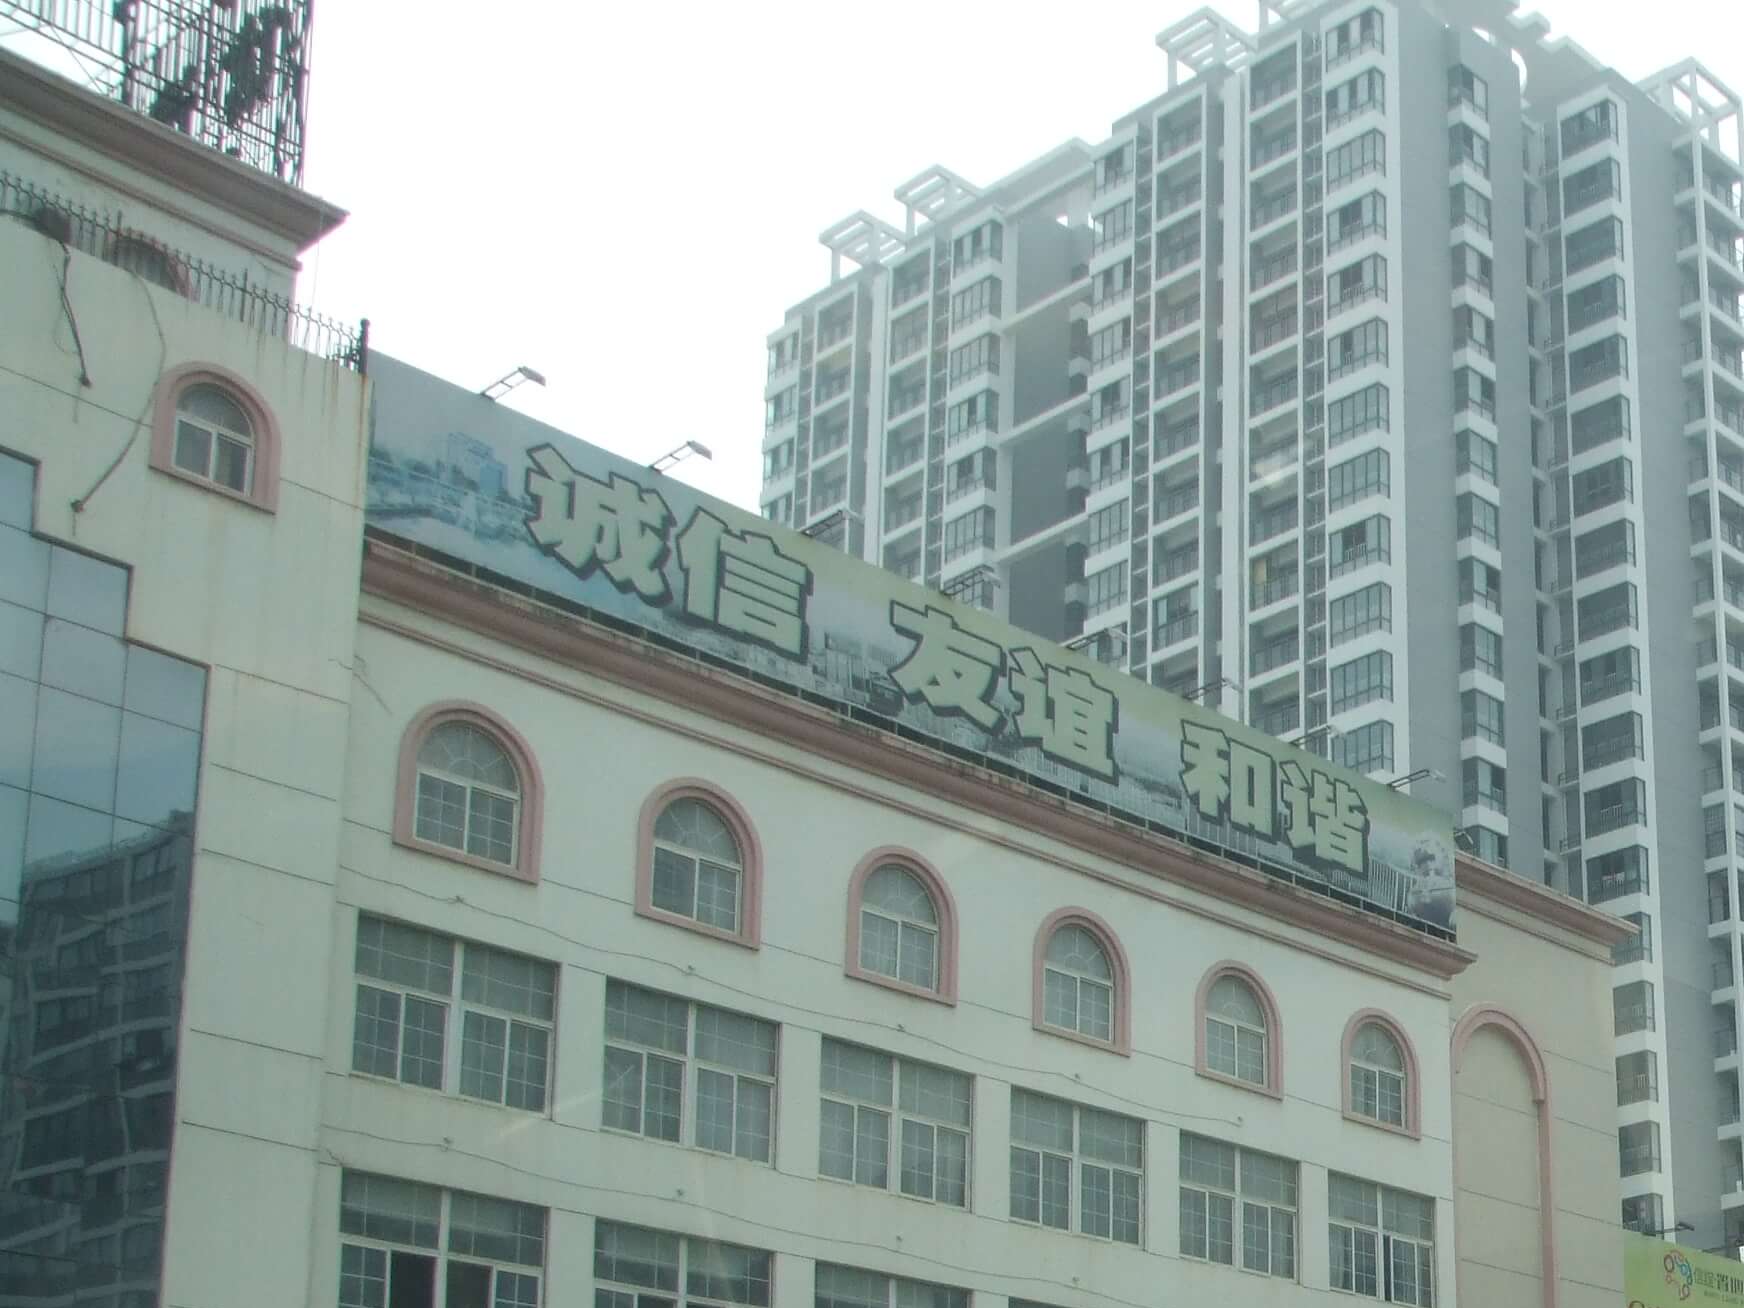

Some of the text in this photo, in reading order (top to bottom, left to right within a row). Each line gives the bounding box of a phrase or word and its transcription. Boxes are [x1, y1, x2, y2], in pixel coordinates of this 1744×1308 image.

[525, 442, 1371, 880] 诚信 友谊 和谐
